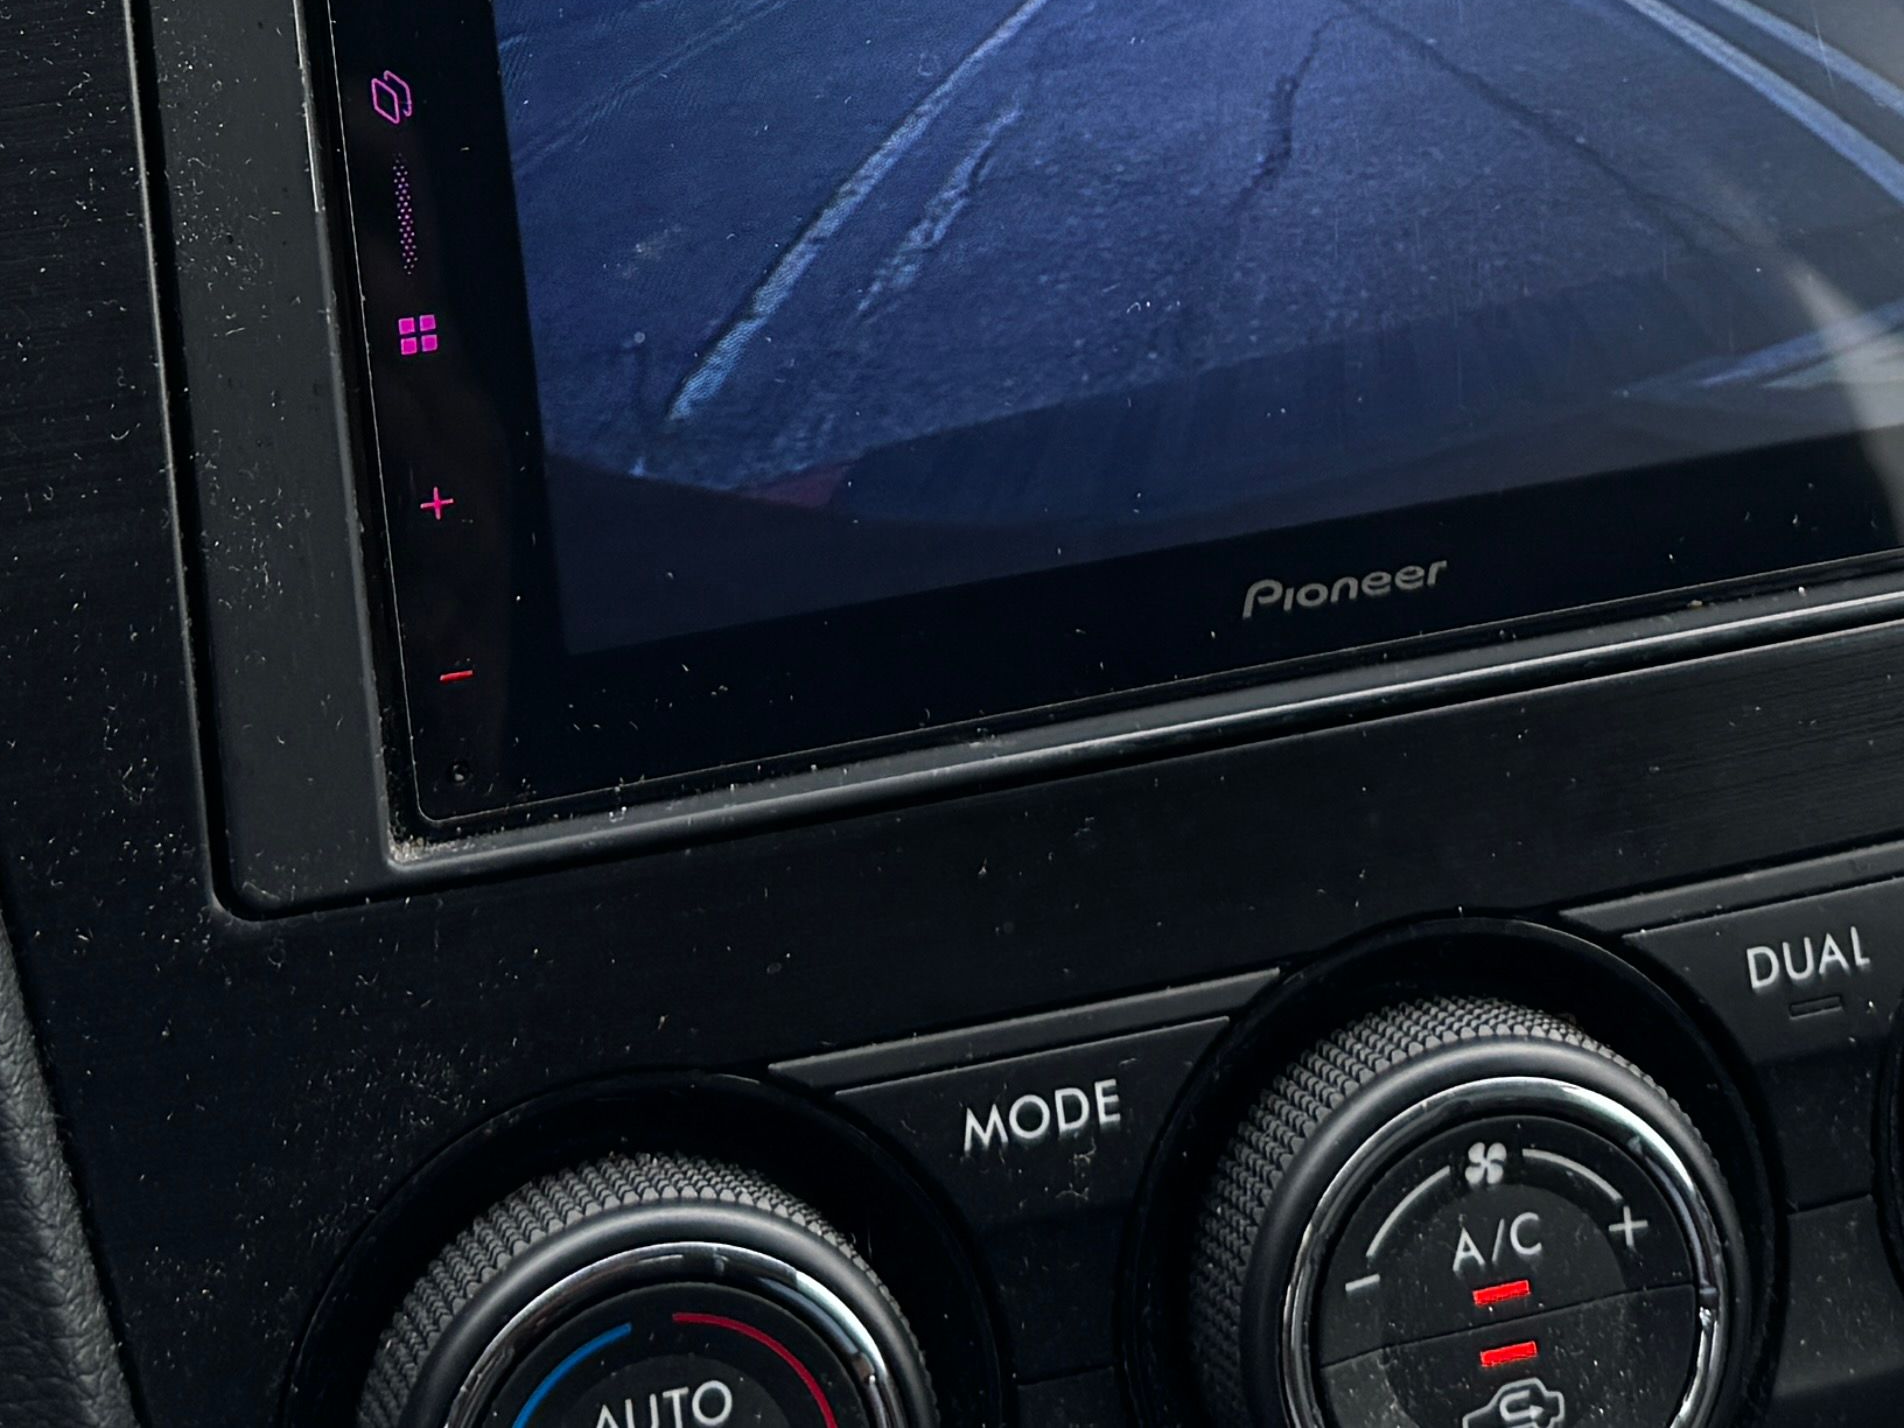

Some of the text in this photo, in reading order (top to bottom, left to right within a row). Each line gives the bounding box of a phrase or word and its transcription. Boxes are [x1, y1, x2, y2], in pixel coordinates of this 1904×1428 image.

[1242, 559, 1448, 620] Pioneer
[1746, 925, 1871, 989] DUAL
[963, 1078, 1122, 1153] MODE
[1452, 1211, 1543, 1272] A/C
[595, 1379, 733, 1428] AUTO
